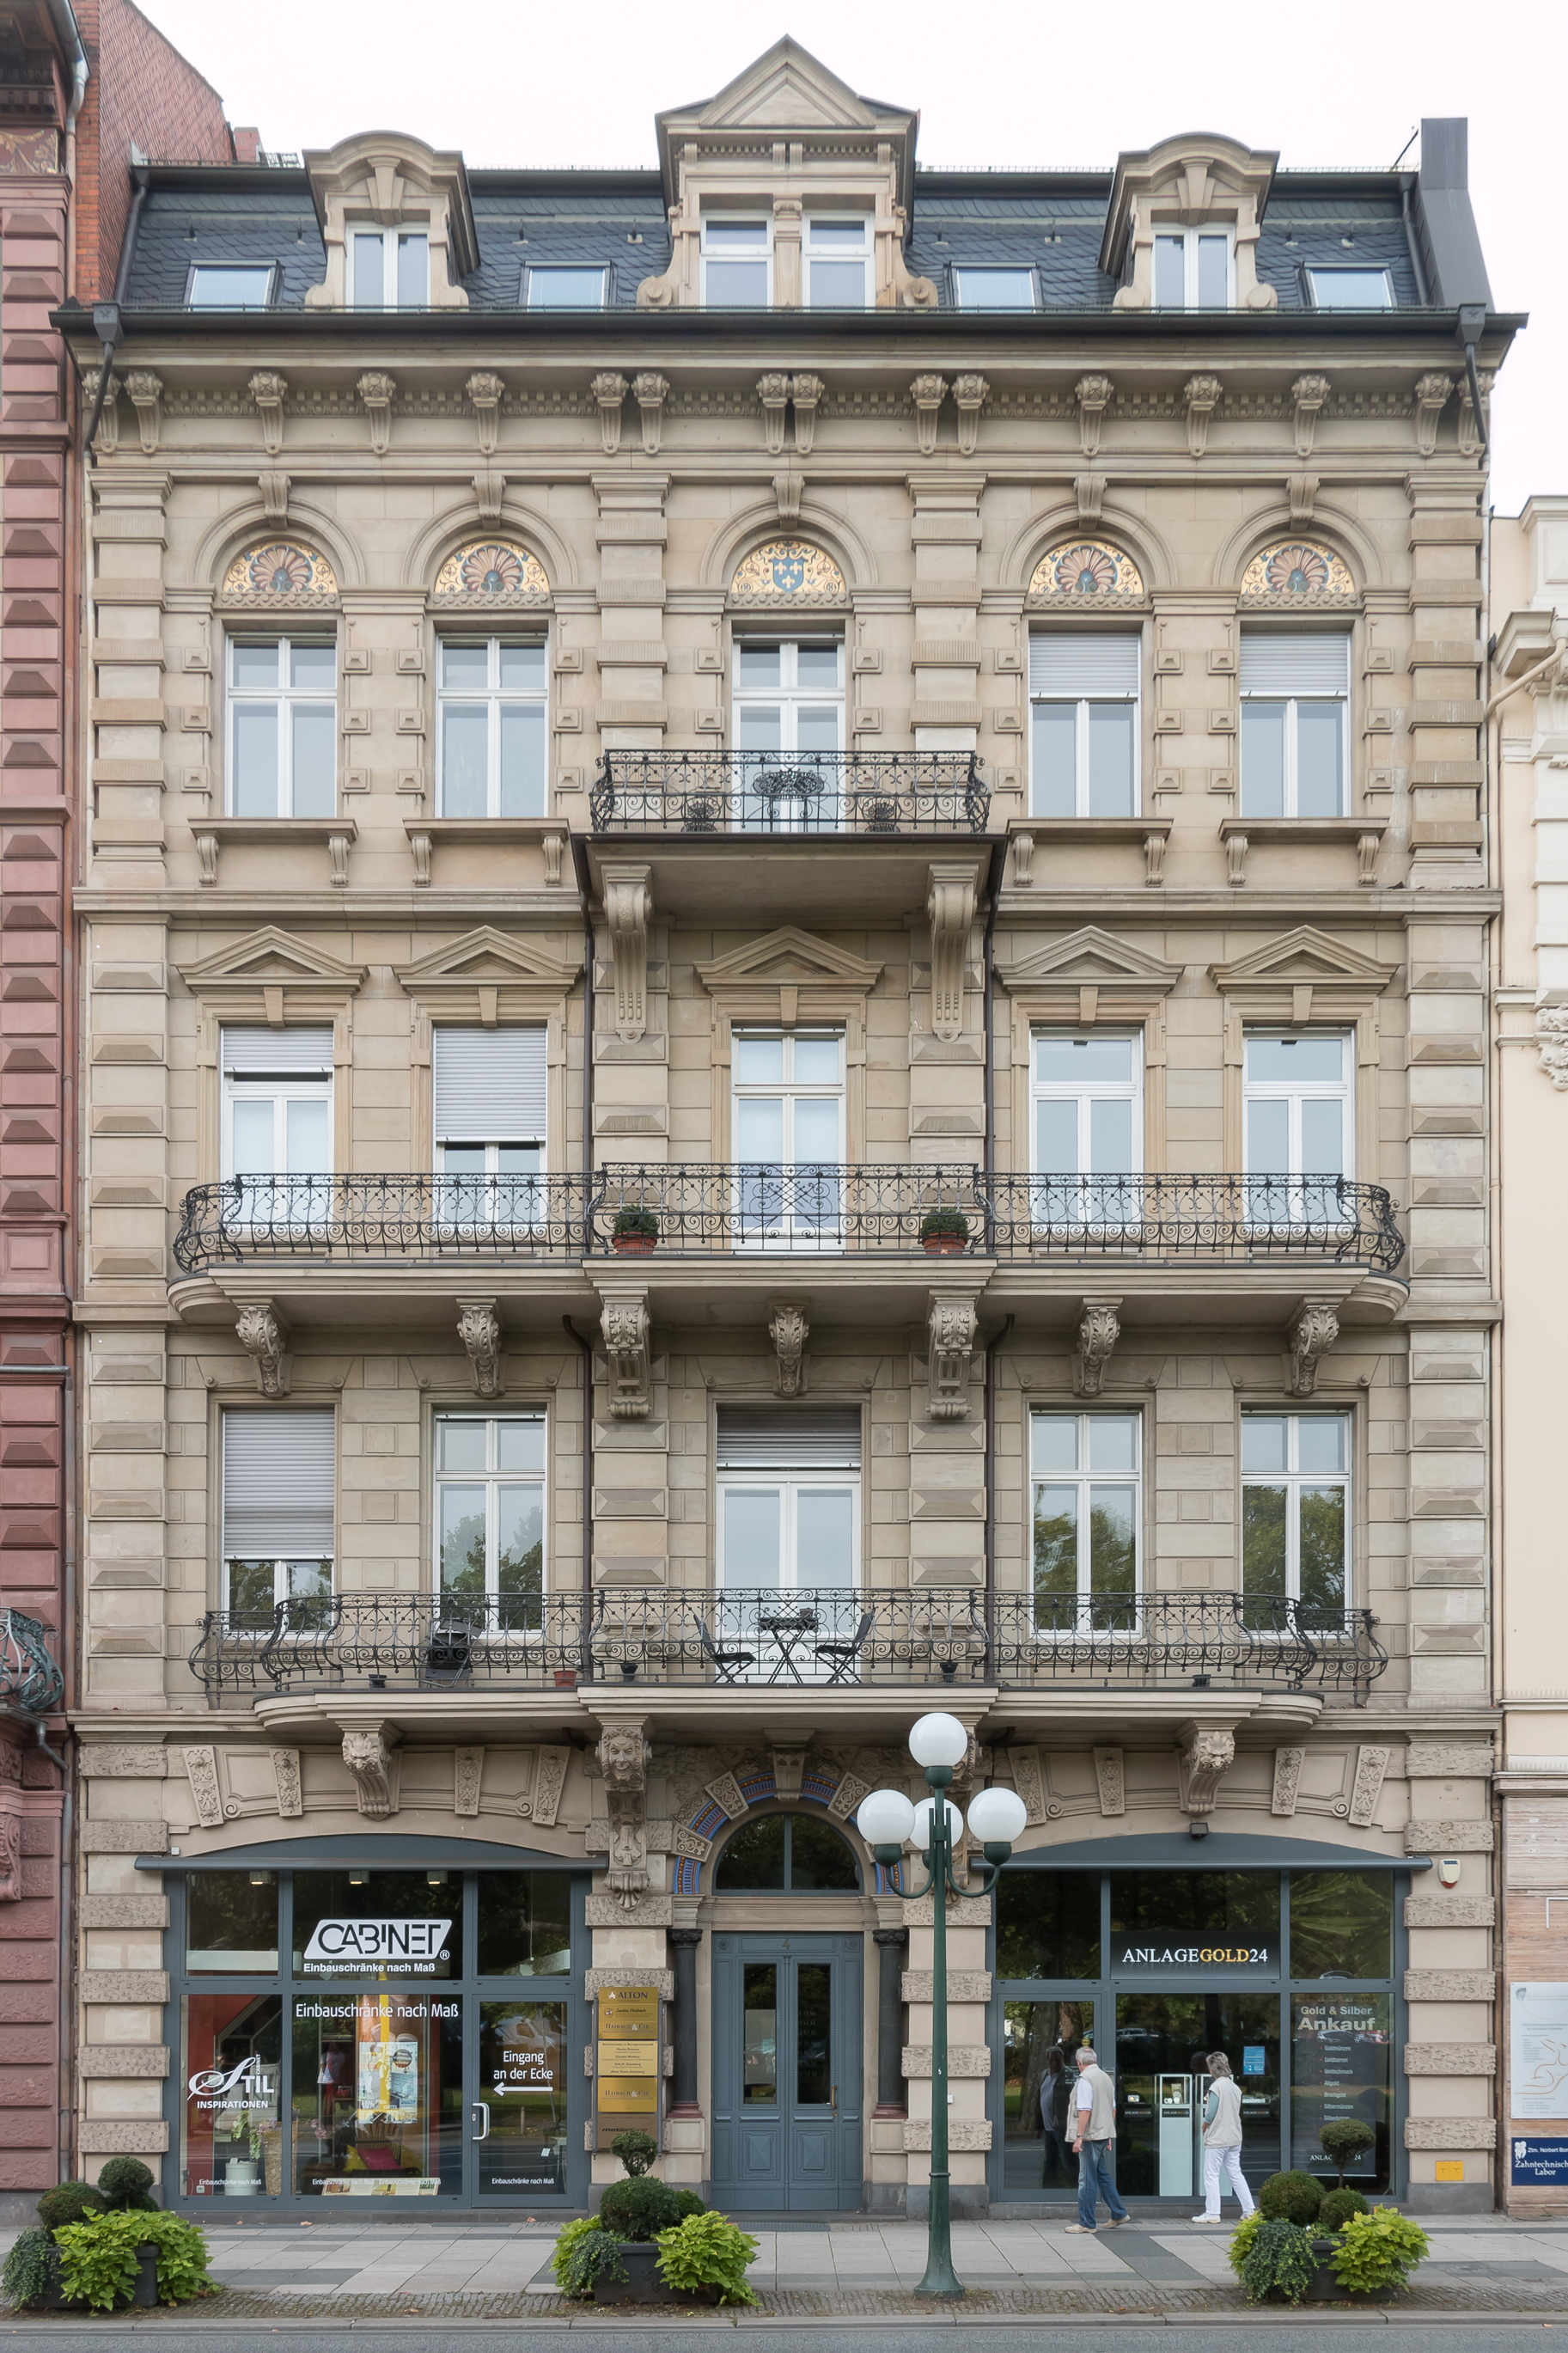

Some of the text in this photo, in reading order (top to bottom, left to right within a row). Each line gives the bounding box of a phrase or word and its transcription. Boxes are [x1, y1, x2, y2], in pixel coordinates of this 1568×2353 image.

[318, 1923, 442, 1954] CABINET
[782, 1938, 790, 1950] 4
[1122, 1948, 1268, 1963] ANLAGEGOLD24
[303, 1963, 436, 1972] Einbauschränke nach Maß
[296, 2002, 459, 2018] Einbauschränke nach Maß
[1301, 2006, 1372, 2015] Gold & Silber
[1297, 2017, 1376, 2031] Ankauf
[503, 2050, 545, 2065] Eingang
[493, 2067, 553, 2080] an der Ecke
[197, 2100, 269, 2109] INSPIRATIONEN
[1534, 2167, 1557, 2176] Labor
